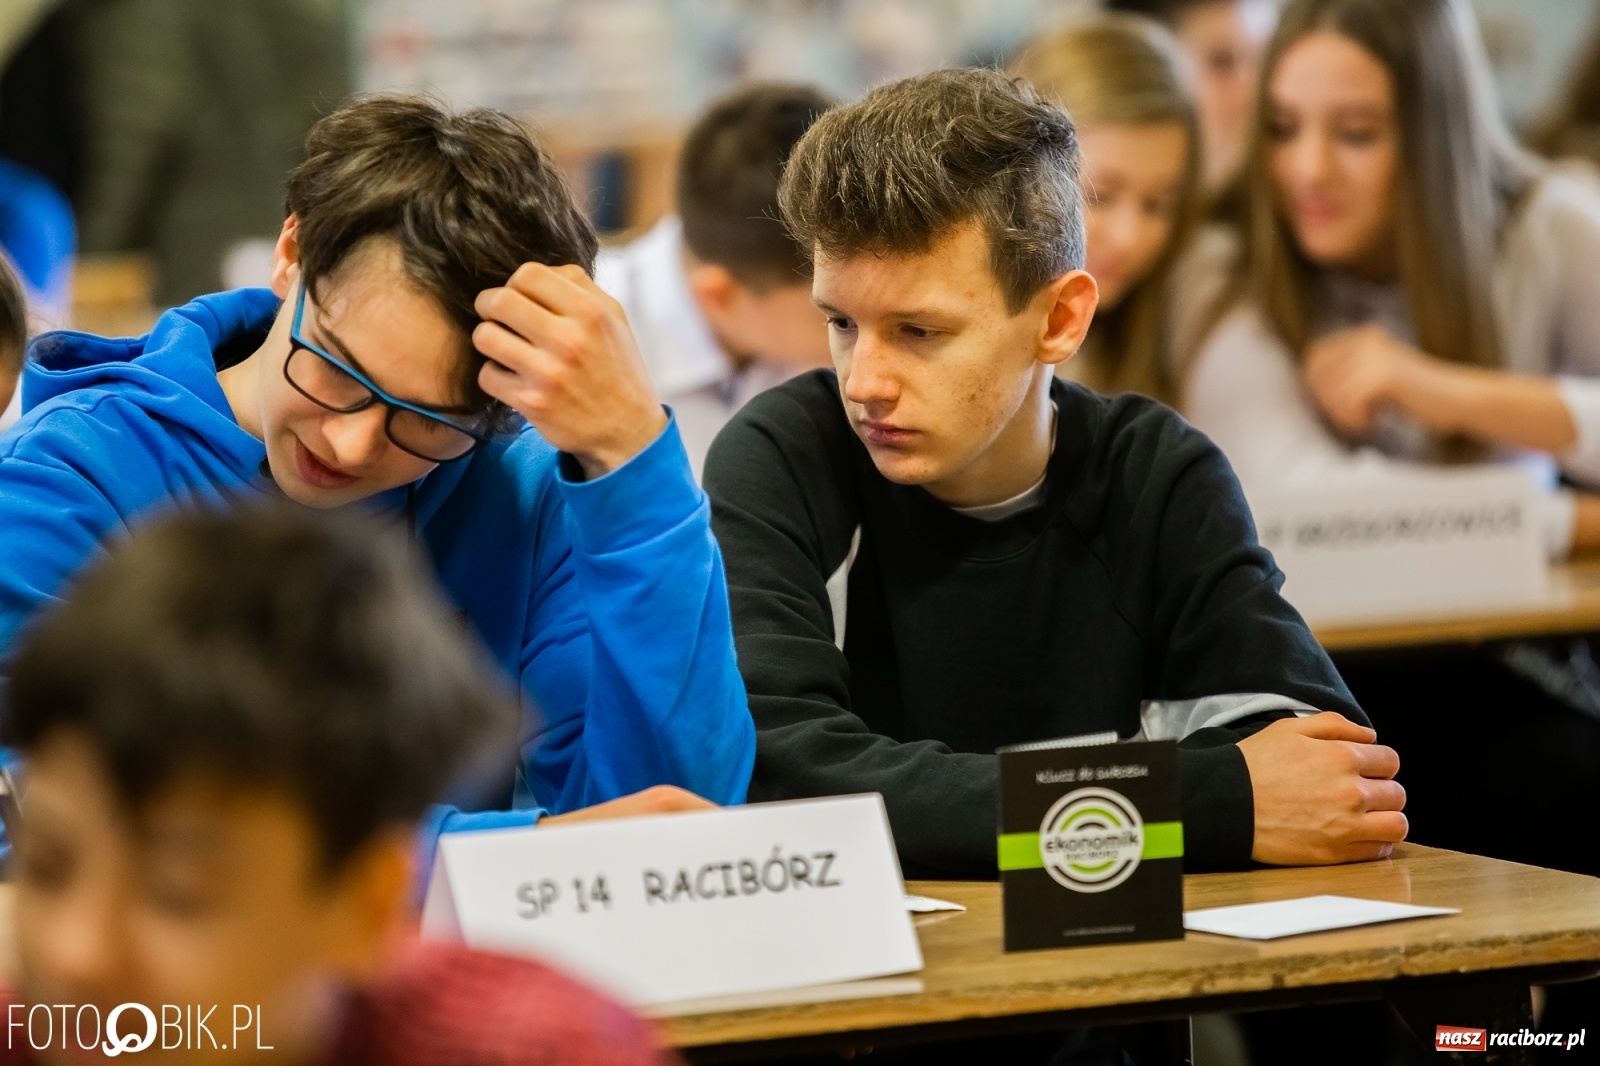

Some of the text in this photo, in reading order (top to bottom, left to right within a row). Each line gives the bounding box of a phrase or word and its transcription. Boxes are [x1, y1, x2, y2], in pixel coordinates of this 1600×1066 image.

[1045, 831, 1139, 852] ekonomik
[516, 844, 842, 919] SP 14 RACIBÓRZ
